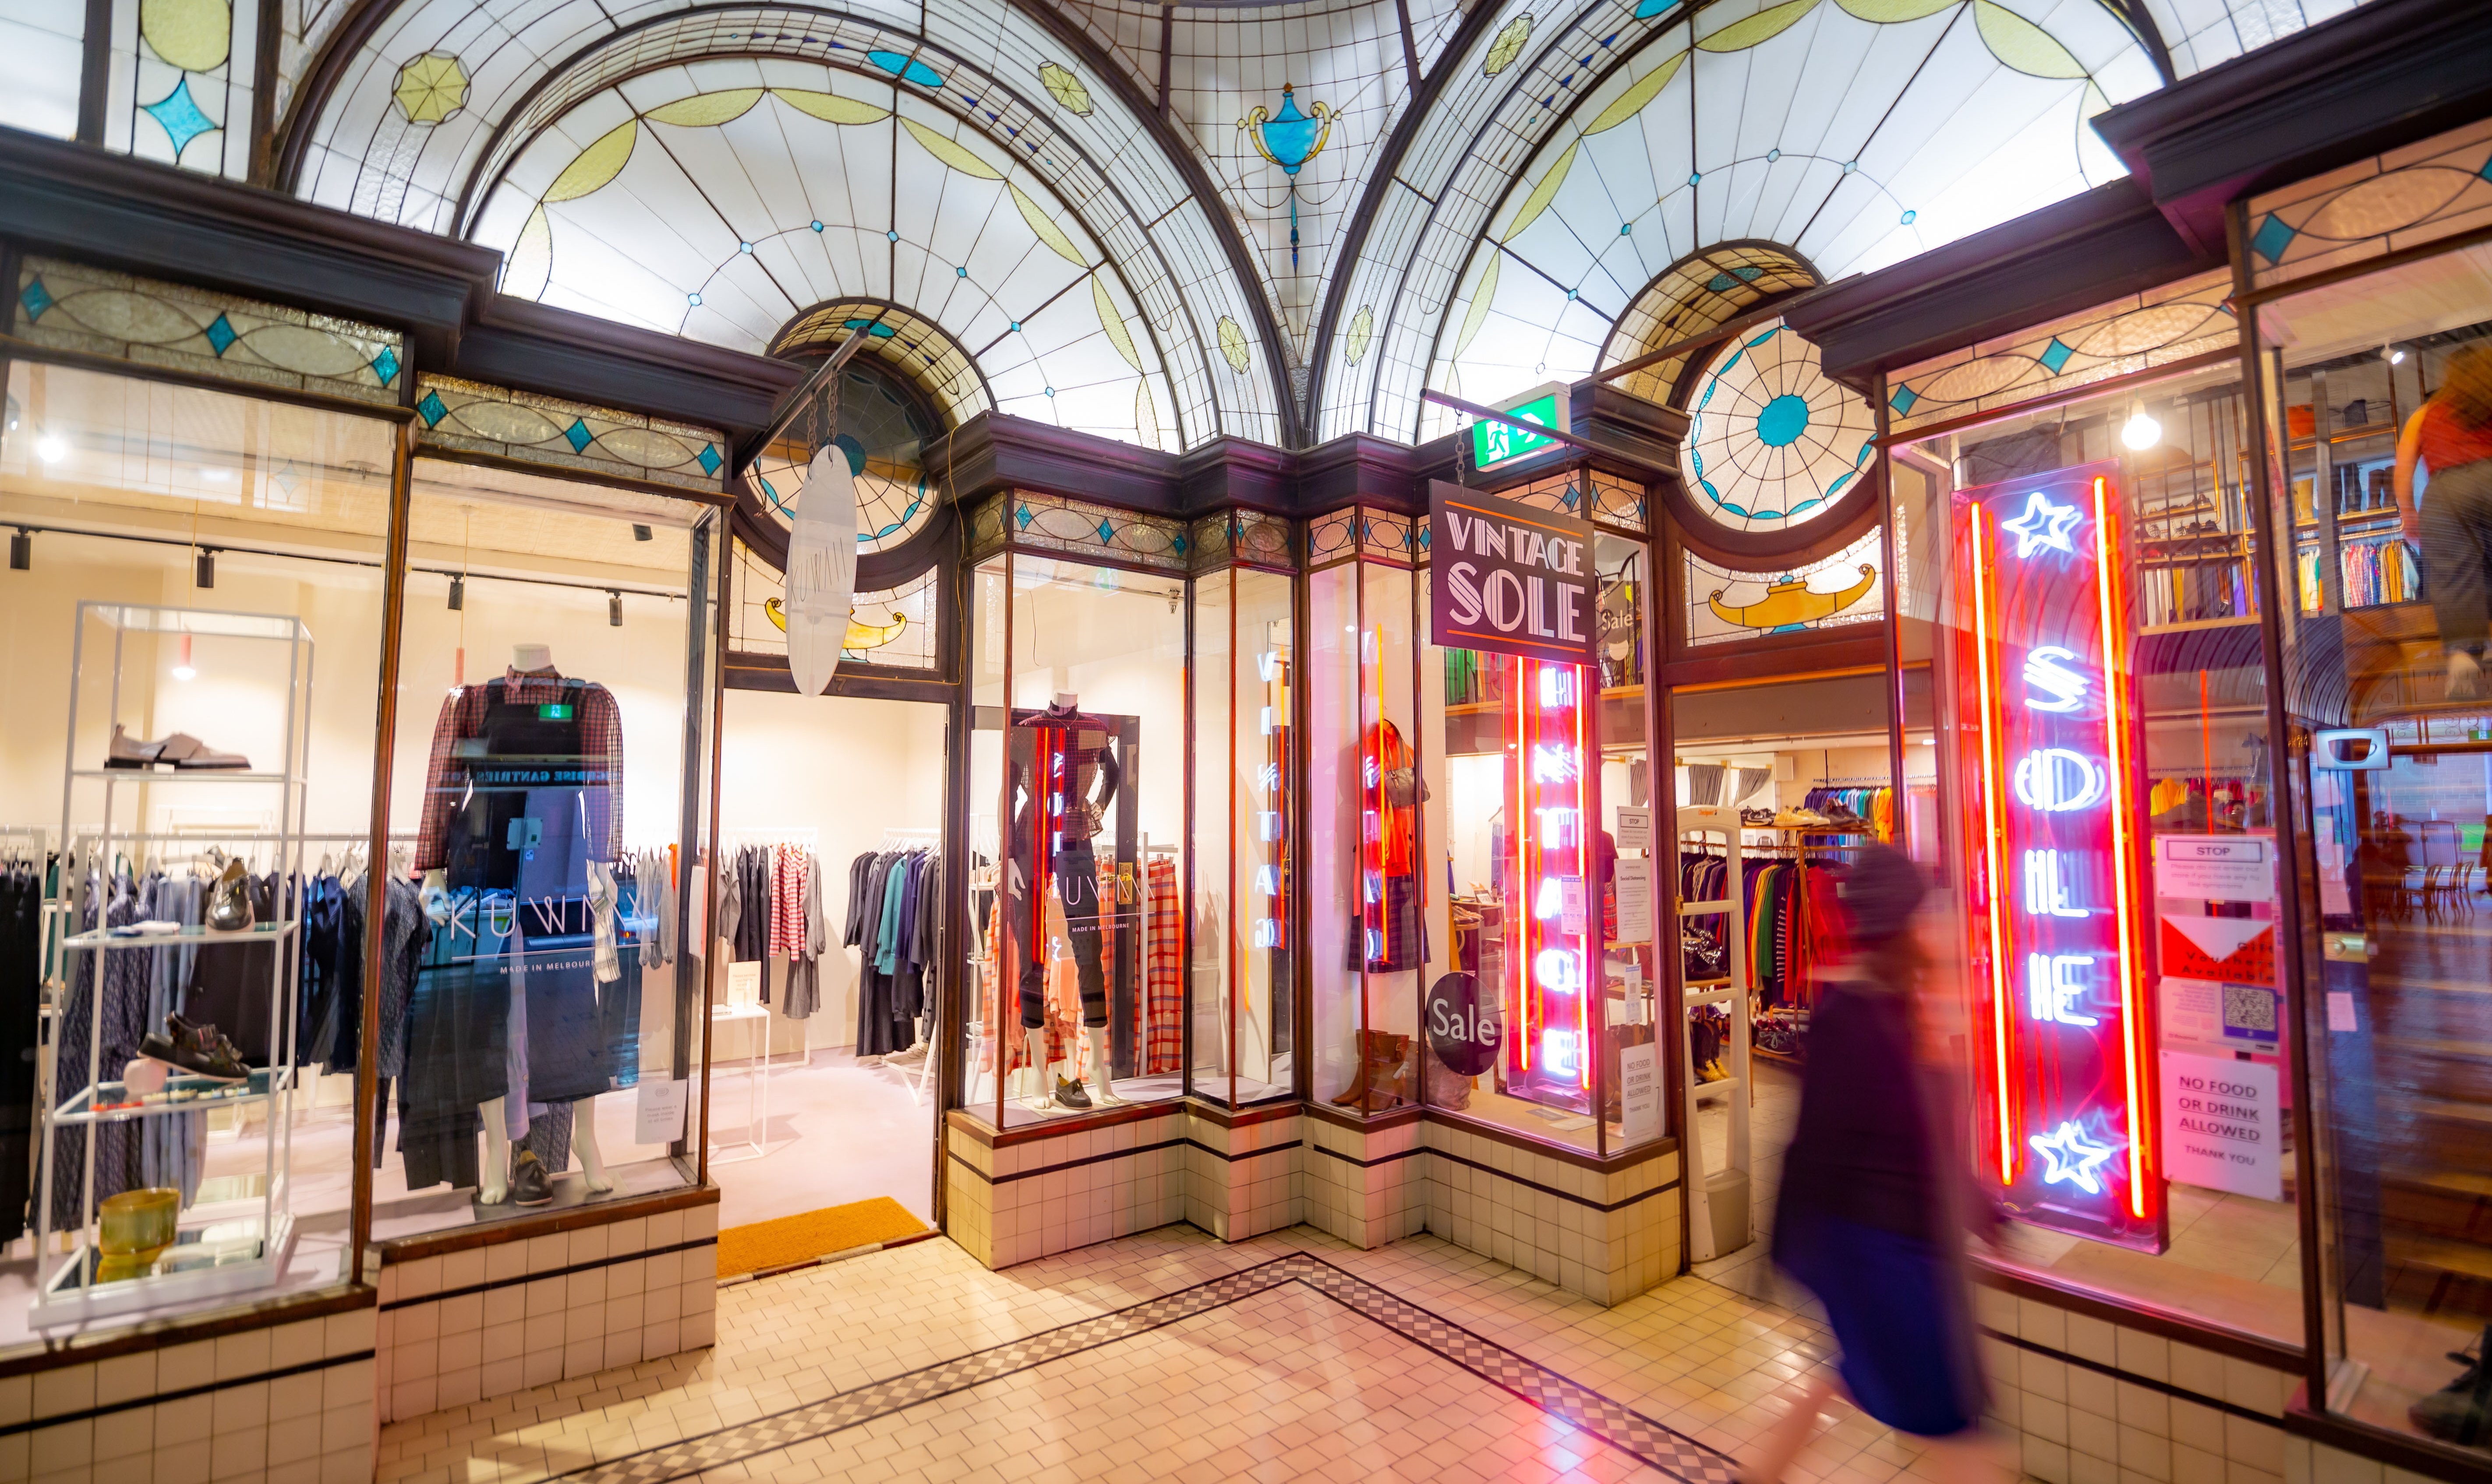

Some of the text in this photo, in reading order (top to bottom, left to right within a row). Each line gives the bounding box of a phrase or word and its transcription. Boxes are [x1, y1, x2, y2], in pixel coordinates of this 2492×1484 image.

[1446, 511, 1584, 577] VINTAGE
[790, 537, 846, 608] KUWAII
[1448, 562, 1586, 643] SOLE
[1602, 609, 1633, 630] Sale
[835, 678, 846, 692] 7
[2196, 847, 2230, 855] STOP
[2186, 952, 2274, 968] Vouchers
[500, 965, 528, 975] MADE
[2182, 965, 2274, 982] Available
[1433, 998, 1495, 1046] Sale
[1636, 1059, 1651, 1068] FOOD
[1636, 1073, 1651, 1082] DRINK
[2179, 1076, 2257, 1098] NO FOOD
[1627, 1085, 1651, 1098] ALLOWED
[1629, 1105, 1641, 1113] THANK
[2179, 1098, 2259, 1121] OR DRINK
[2179, 1118, 2260, 1141] ALLOWED
[2185, 1145, 2255, 1166] THANK YOU
